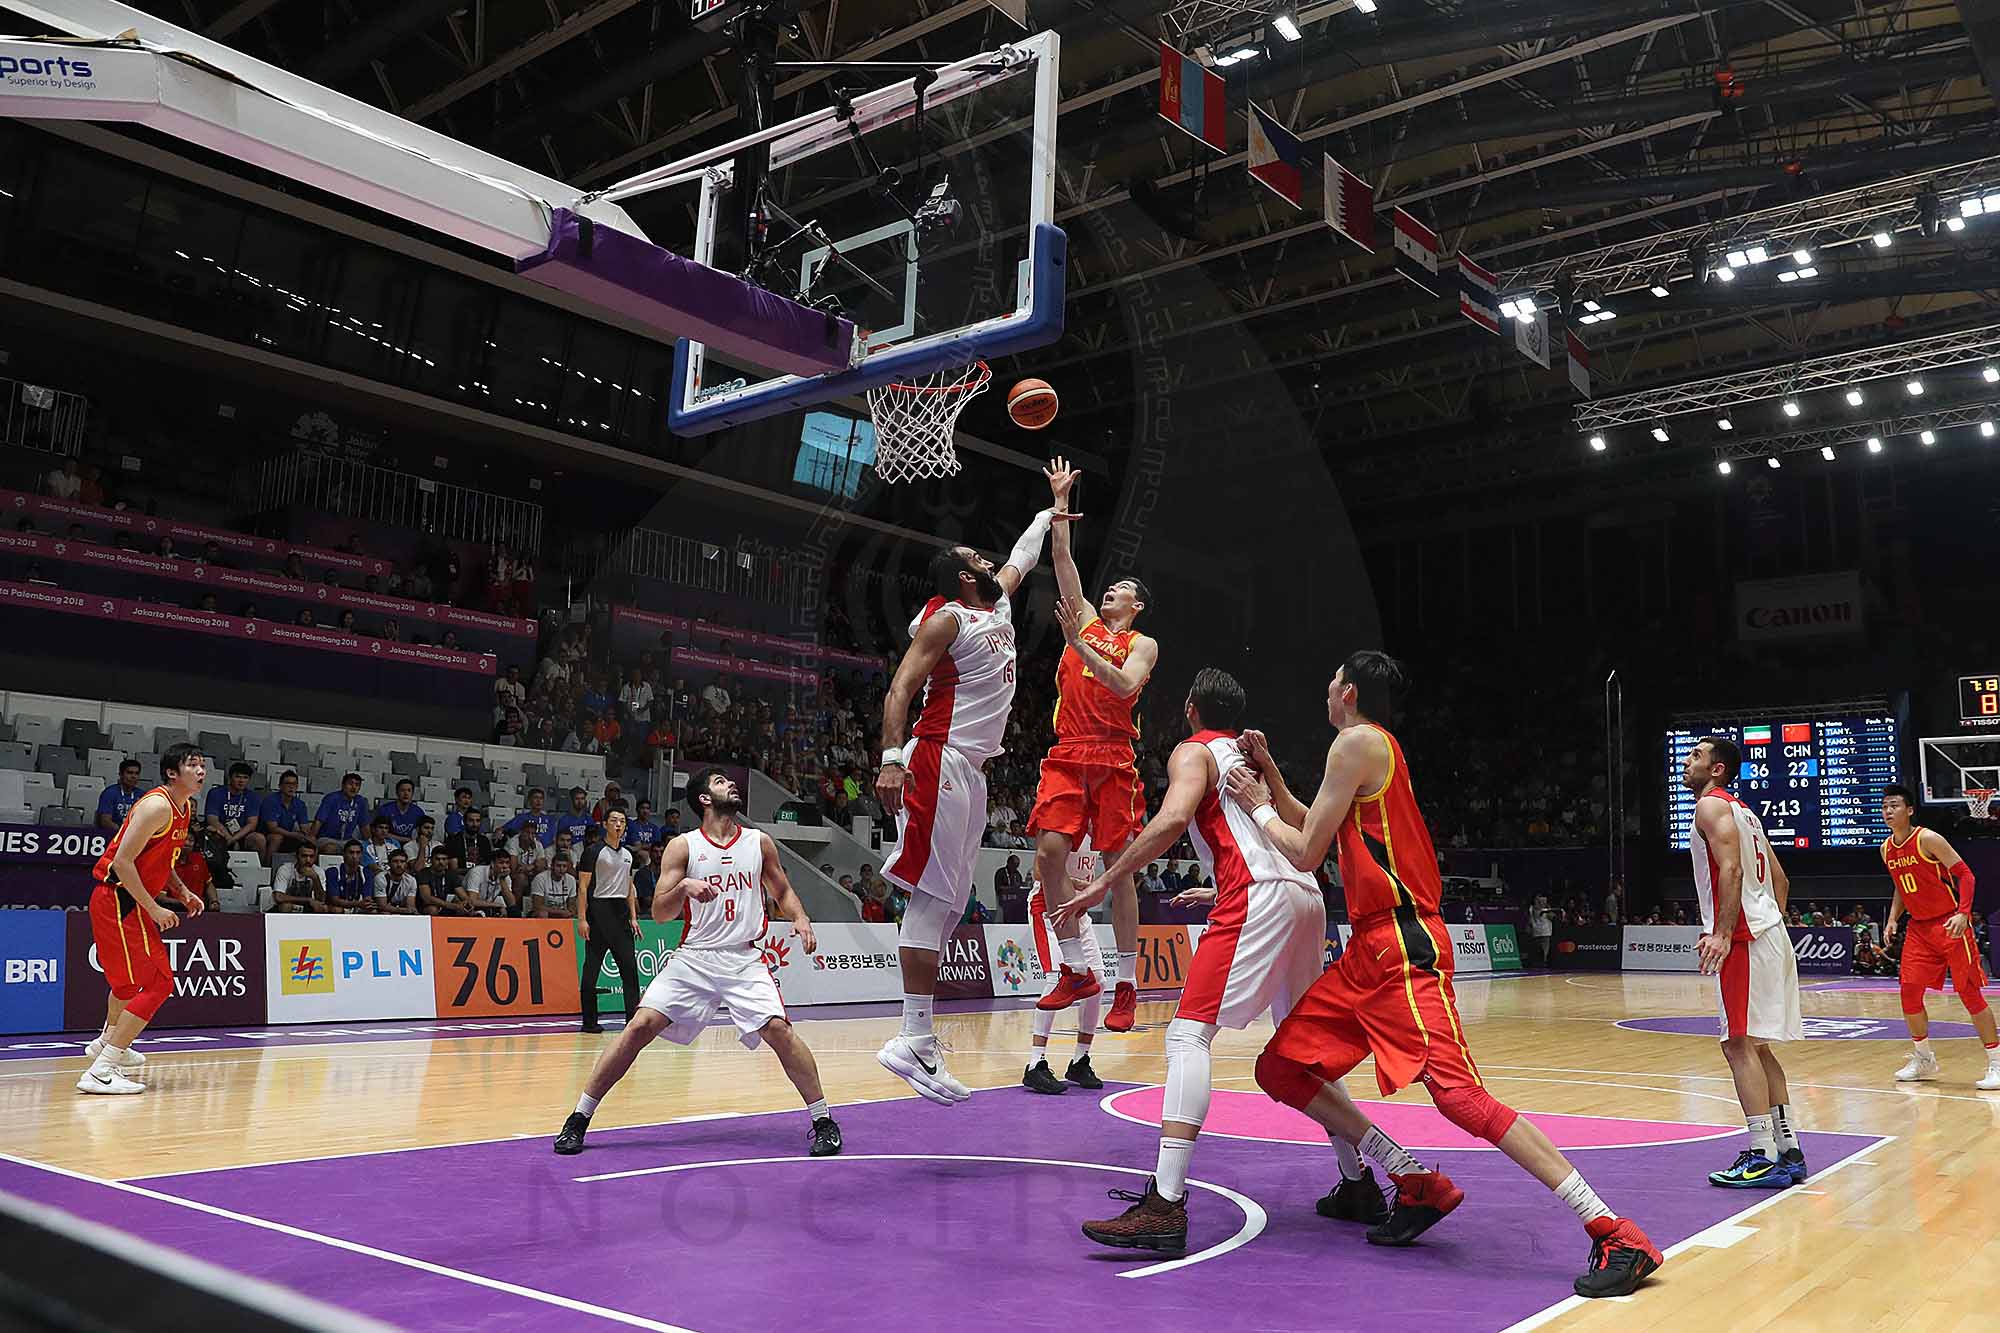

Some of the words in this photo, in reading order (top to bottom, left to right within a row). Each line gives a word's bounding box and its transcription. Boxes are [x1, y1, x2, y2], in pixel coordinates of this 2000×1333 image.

[8, 76, 48, 87] Superior
[51, 79, 62, 89] by
[64, 79, 97, 90] Design
[11, 588, 62, 604] Palembang
[64, 596, 84, 607] 2018
[132, 607, 165, 619] Jakarta
[166, 611, 211, 627] Palembang
[212, 618, 230, 629] 2018
[1745, 602, 1853, 629] Canon
[985, 631, 1016, 655] IRAN
[1082, 633, 1127, 663] CHINA
[1981, 694, 1998, 715] 8
[1887, 725, 1894, 733] 0
[1750, 747, 1767, 760] IRI
[1783, 744, 1812, 758] CHN
[1827, 747, 1849, 755] ZHAO
[1888, 745, 1895, 753] 0
[1819, 758, 1825, 766] 7
[1889, 755, 1896, 763] 0
[1749, 763, 1770, 778] 36
[1788, 761, 1809, 776] 22
[1820, 778, 1828, 786] 10
[1828, 777, 1851, 785] ZHAO
[1890, 775, 1896, 783] 2
[1819, 788, 1829, 796] 11
[1760, 799, 1801, 817] 7:13
[1830, 797, 1852, 805] ZHOU
[781, 811, 793, 820] EXIT
[1830, 807, 1854, 815] DONG
[1777, 818, 1784, 827] 2
[46, 834, 106, 856] 2018
[1798, 838, 1806, 847] 0
[1822, 838, 1831, 846] 31
[1832, 837, 1857, 846] WANG
[1752, 834, 1766, 884] 5
[1887, 855, 1919, 870] CHINA
[1899, 872, 1918, 894] 10
[725, 898, 735, 922] 8
[1456, 942, 1486, 955] TISSOT
[1492, 934, 1515, 954] Grab
[1577, 941, 1618, 951] mastercard
[341, 948, 423, 979] PLN
[825, 953, 898, 970] 쌍용정보통신
[5, 959, 57, 984] BRI
